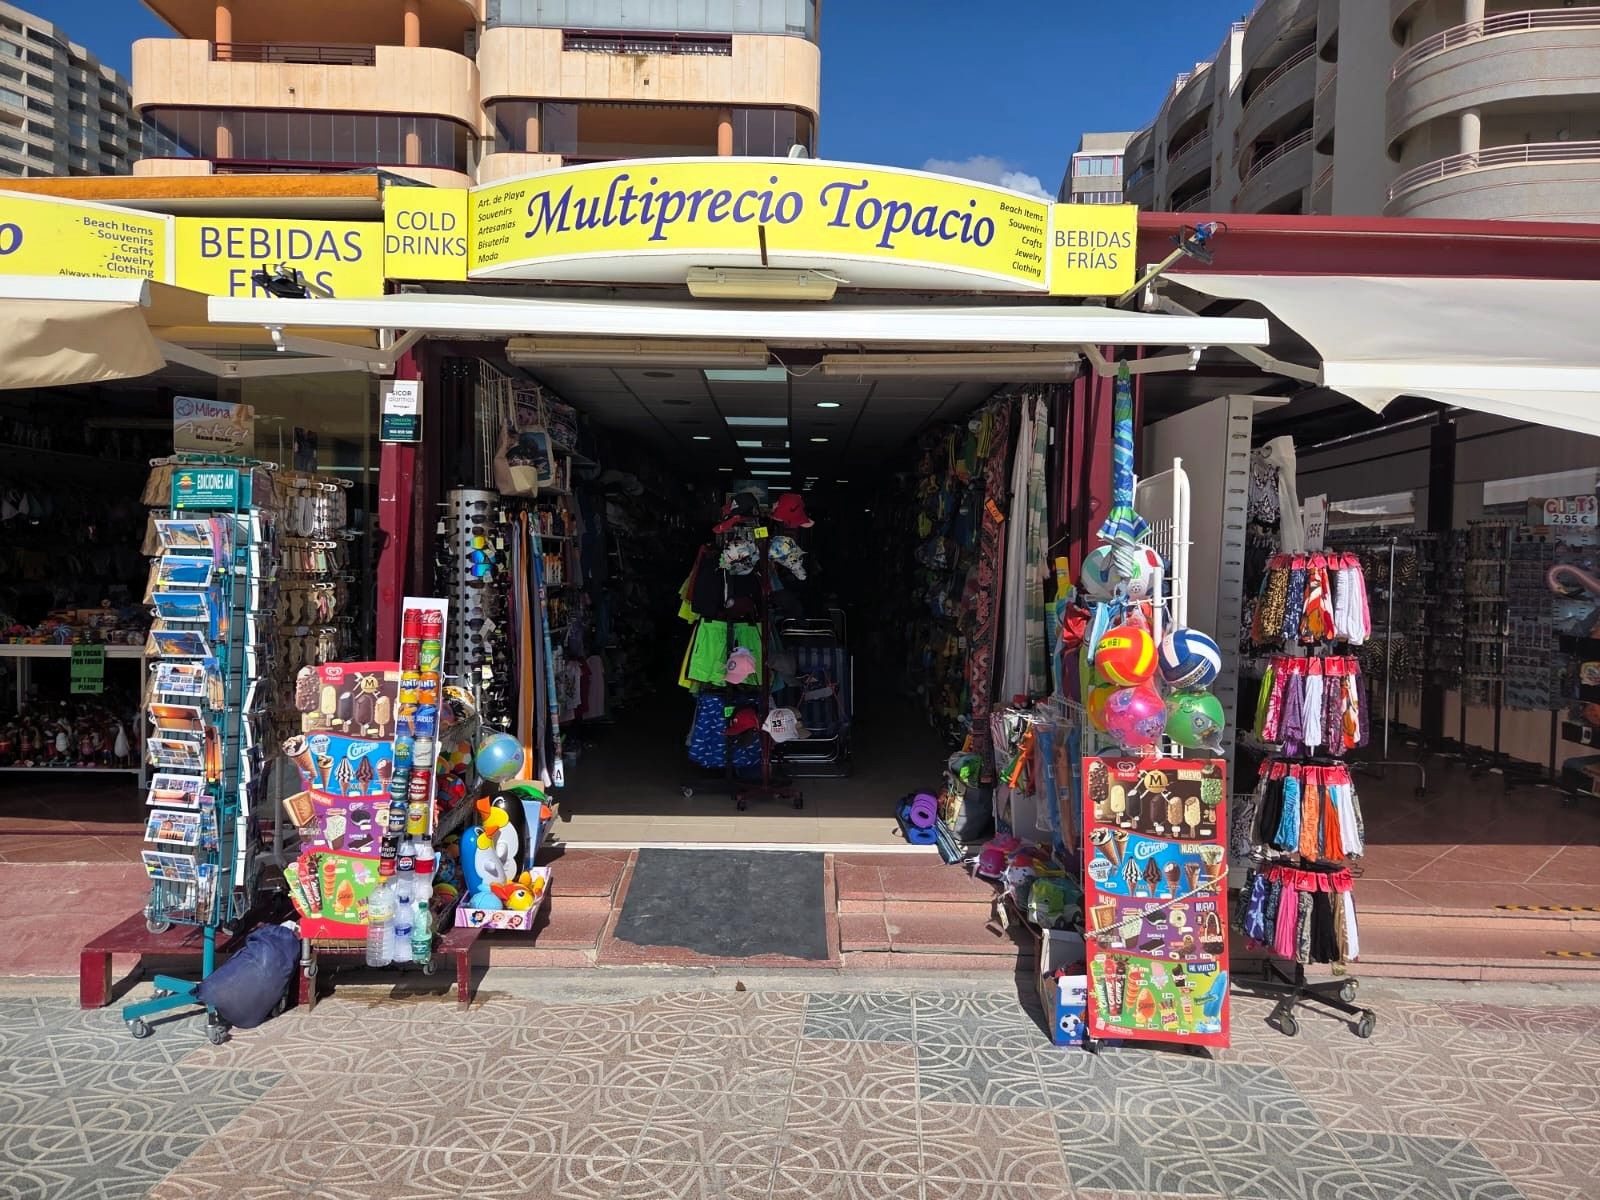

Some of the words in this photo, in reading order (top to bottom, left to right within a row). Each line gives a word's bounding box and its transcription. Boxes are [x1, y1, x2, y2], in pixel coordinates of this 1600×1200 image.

[493, 194, 502, 204] de
[504, 190, 526, 202] Playa
[478, 207, 513, 222] Souvenirs
[525, 174, 803, 241] Multiprecio
[820, 179, 995, 250] Topacio
[999, 202, 1022, 216] Beach
[1023, 206, 1044, 222] Items
[83, 217, 119, 230] Beach
[122, 223, 153, 235] Items
[396, 210, 456, 232] COLD
[1008, 218, 1043, 236] Souvenirs
[97, 230, 154, 246] Souvenirs
[201, 227, 363, 263] BEBIDAS
[386, 235, 467, 257] DRINKS
[1021, 235, 1043, 249] Crafts
[1055, 230, 1132, 249] BEBIDAS
[121, 243, 154, 256] Crafts
[478, 251, 499, 263] Moda
[1015, 248, 1042, 263] Jewelry
[110, 253, 154, 268] Jewelry
[1067, 247, 1118, 270] FRÍAS
[106, 262, 154, 279] Clothing
[1012, 261, 1042, 277] Clothing
[195, 402, 231, 419] Milena
[197, 474, 224, 490] EDICIONES
[1553, 514, 1578, 525] 2,95
[1581, 515, 1589, 524] €
[1149, 775, 1162, 786] M
